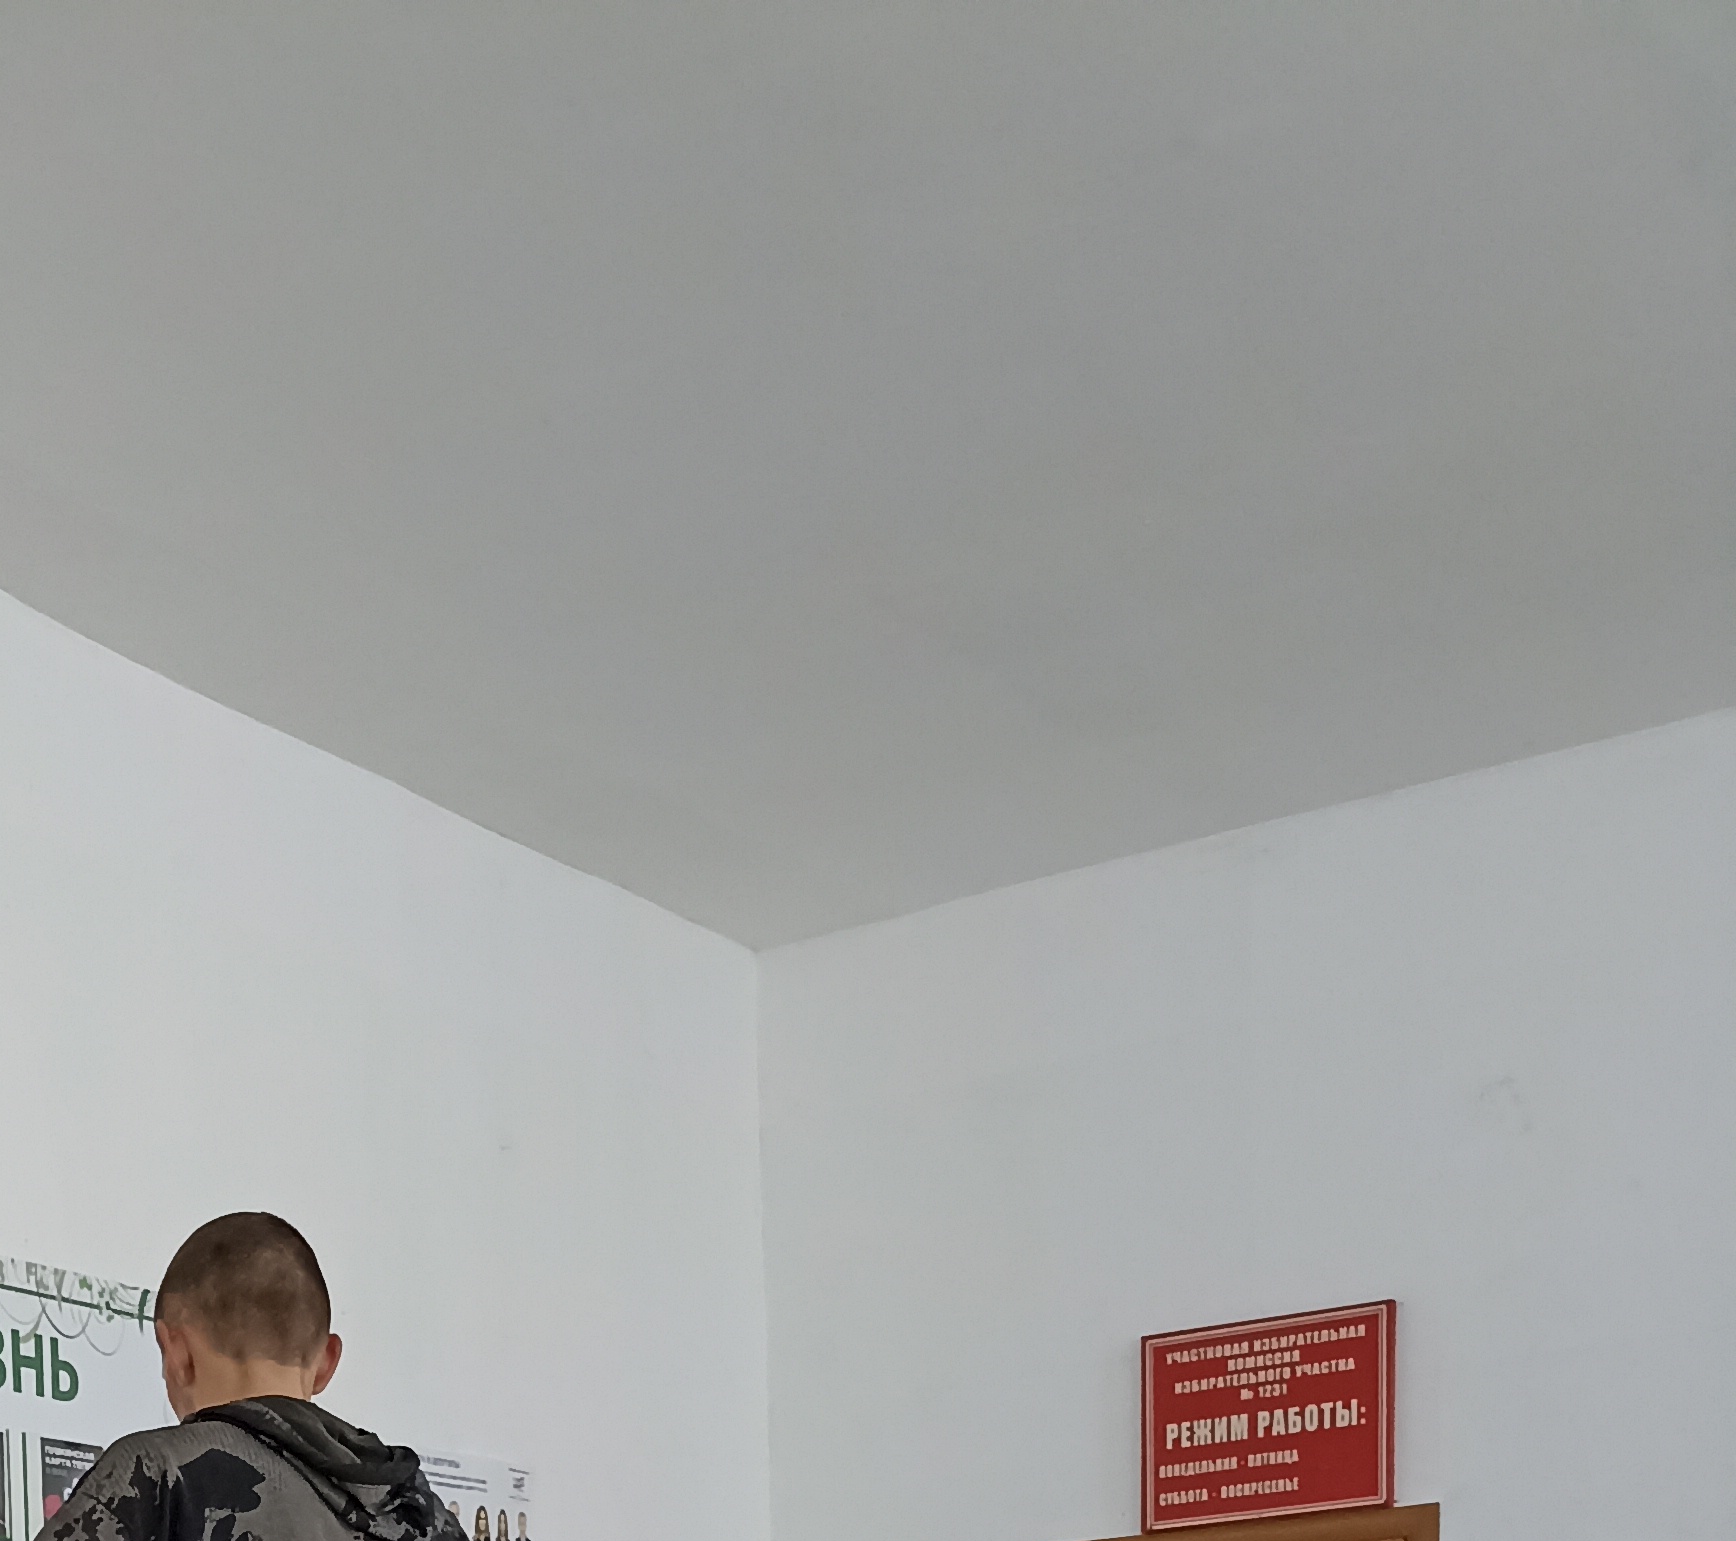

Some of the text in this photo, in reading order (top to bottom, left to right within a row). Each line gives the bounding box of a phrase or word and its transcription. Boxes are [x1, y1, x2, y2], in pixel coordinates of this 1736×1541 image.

[1166, 1324, 1366, 1365] УЧАСТКОВАЯ ИЗБИРАТЕЛЬНАЯ
[1174, 1357, 1356, 1394] ИЗБИРАТЕЛЬНОГО УЧАСТКА
[1227, 1350, 1300, 1371] КОМИССИЯ
[1258, 1384, 1288, 1397] 1231
[1166, 1399, 1366, 1450] РЕЖИМ РАБОТЫ:
[1159, 1456, 1238, 1479] ПОНЕДЕЛЬНИК
[1247, 1449, 1299, 1468] ПЯТНИЦА
[1159, 1488, 1208, 1507] СУББОТА
[1220, 1477, 1299, 1499] ВОСКРЕСЕНЬЕ
